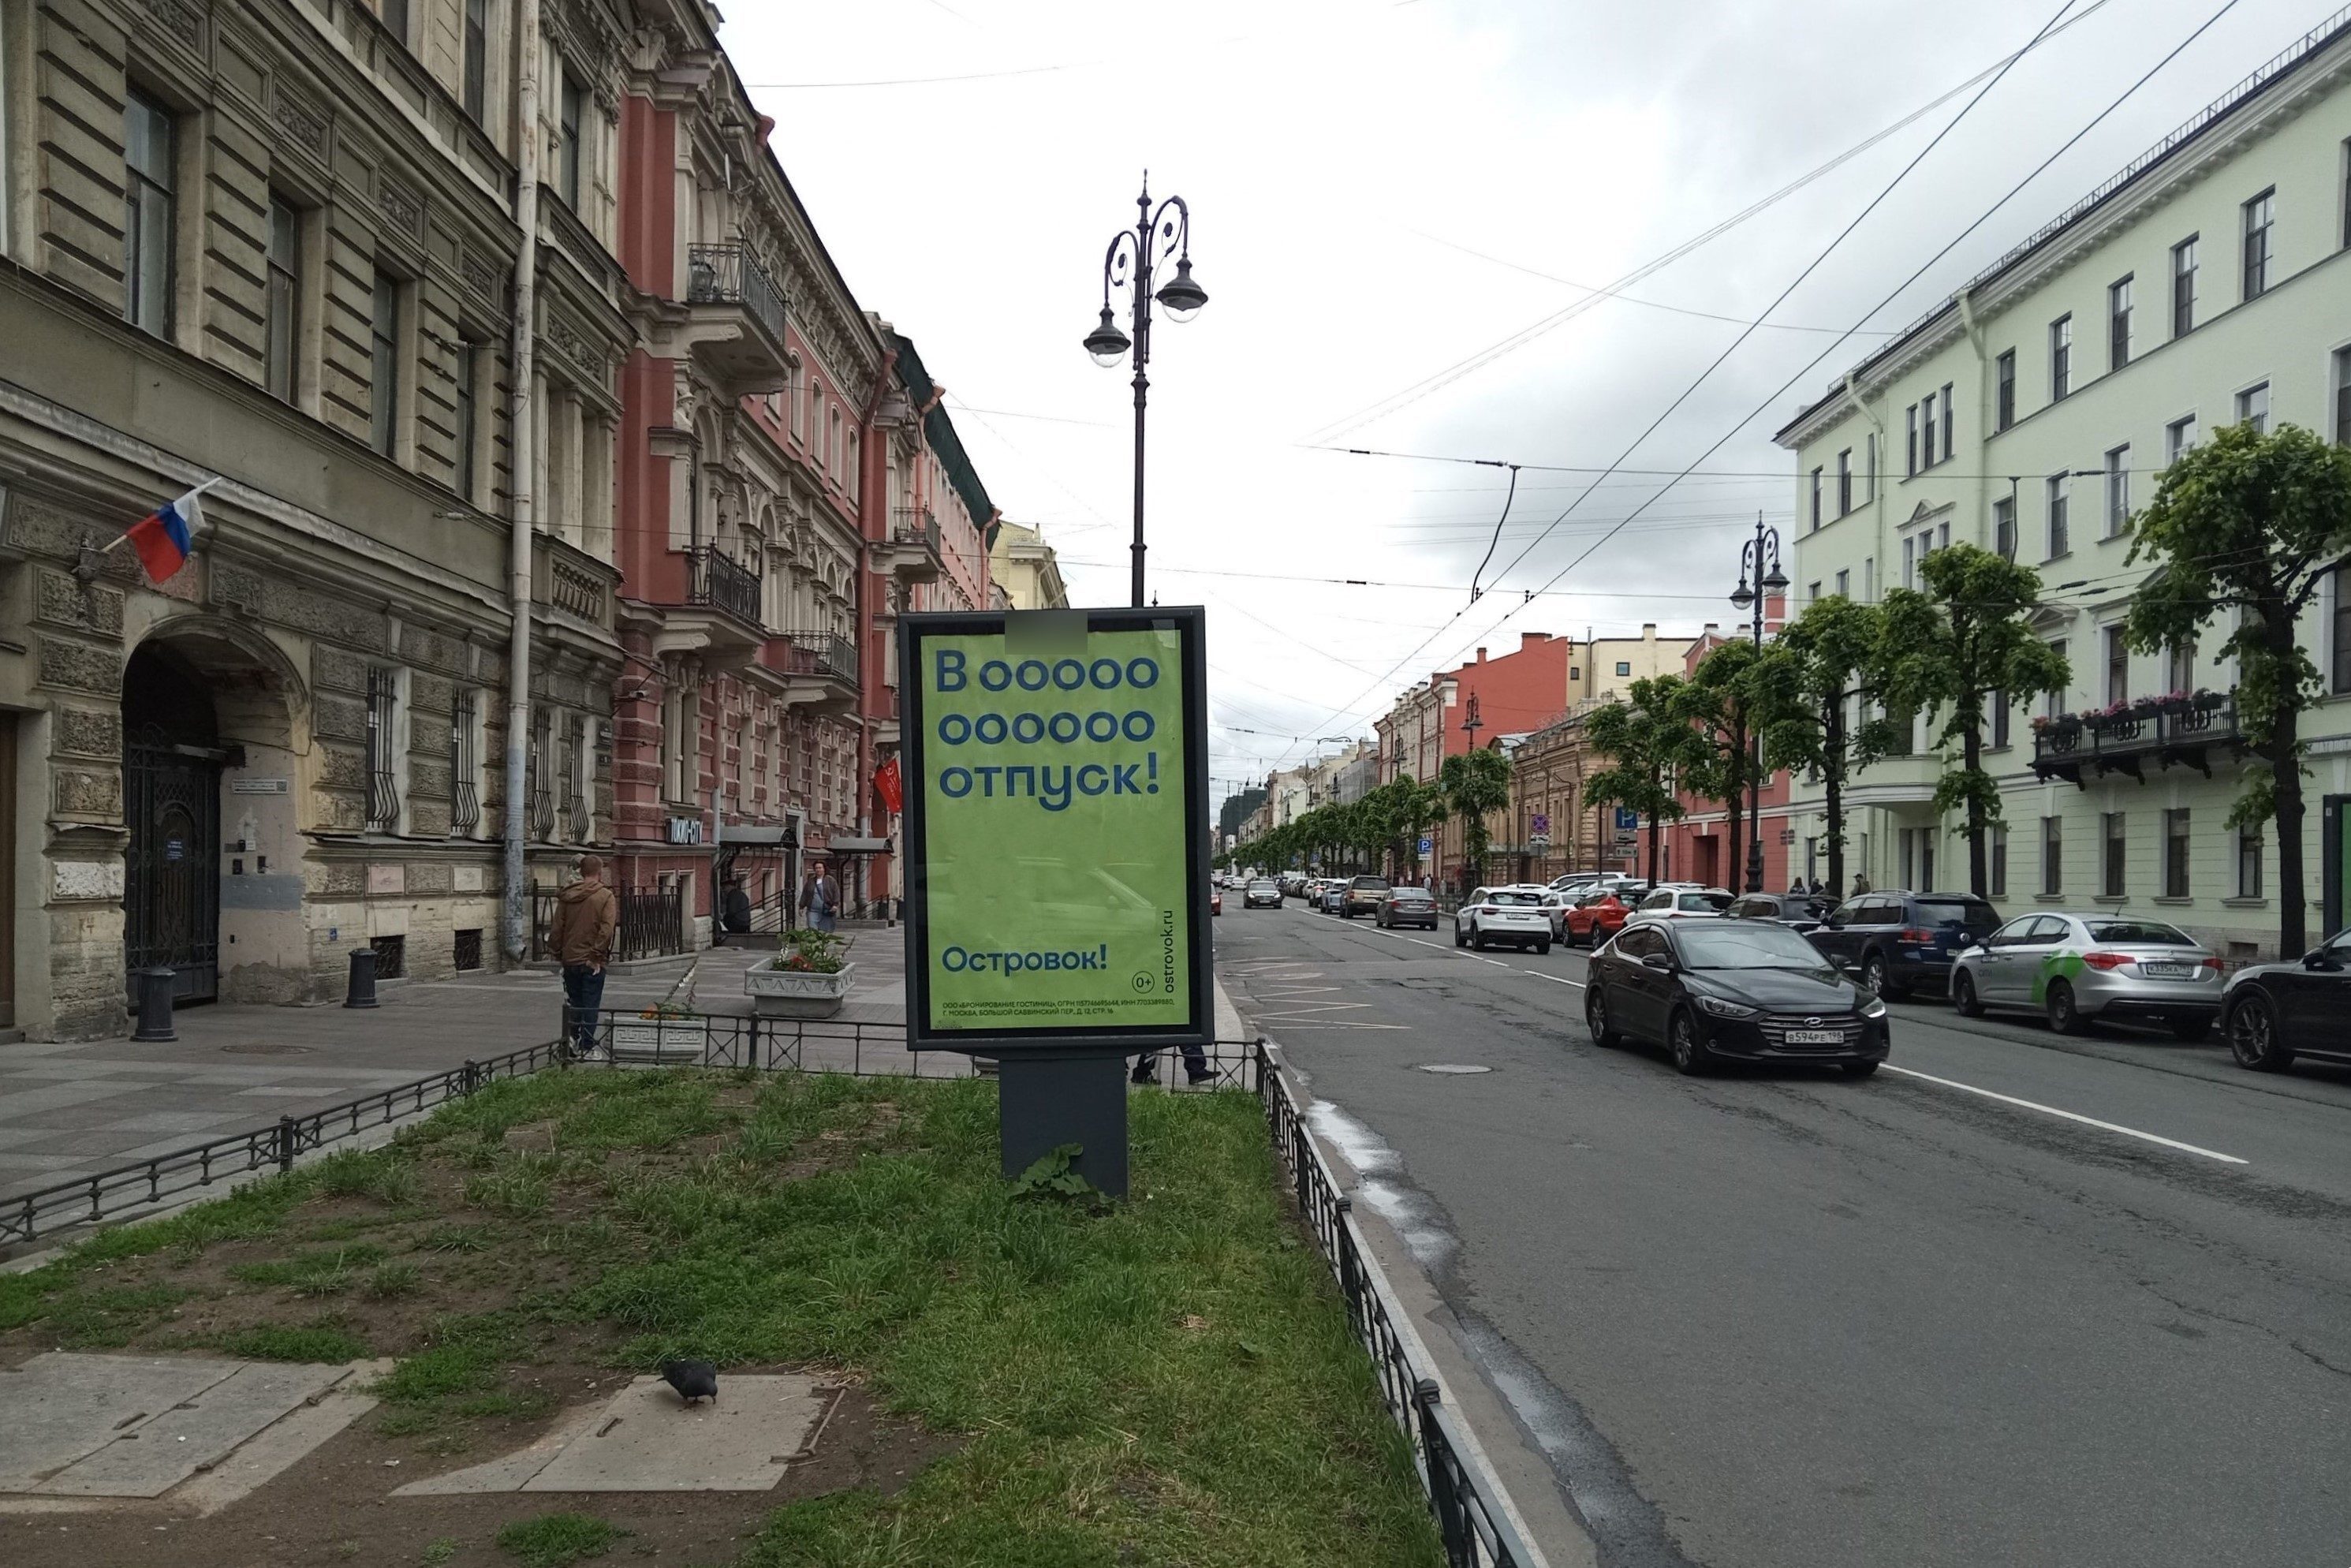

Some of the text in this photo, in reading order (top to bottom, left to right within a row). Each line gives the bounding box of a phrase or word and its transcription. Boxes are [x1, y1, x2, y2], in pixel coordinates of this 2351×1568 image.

[936, 649, 1159, 693] В ооооо
[938, 710, 1155, 745] оооооо
[939, 752, 1159, 812] отпуск!
[942, 944, 1107, 977] Островок!
[1160, 910, 1174, 993] ostrovok.ru
[1136, 977, 1151, 987] 0+
[1013, 1007, 1059, 1016] САВВИНСКИЙ
